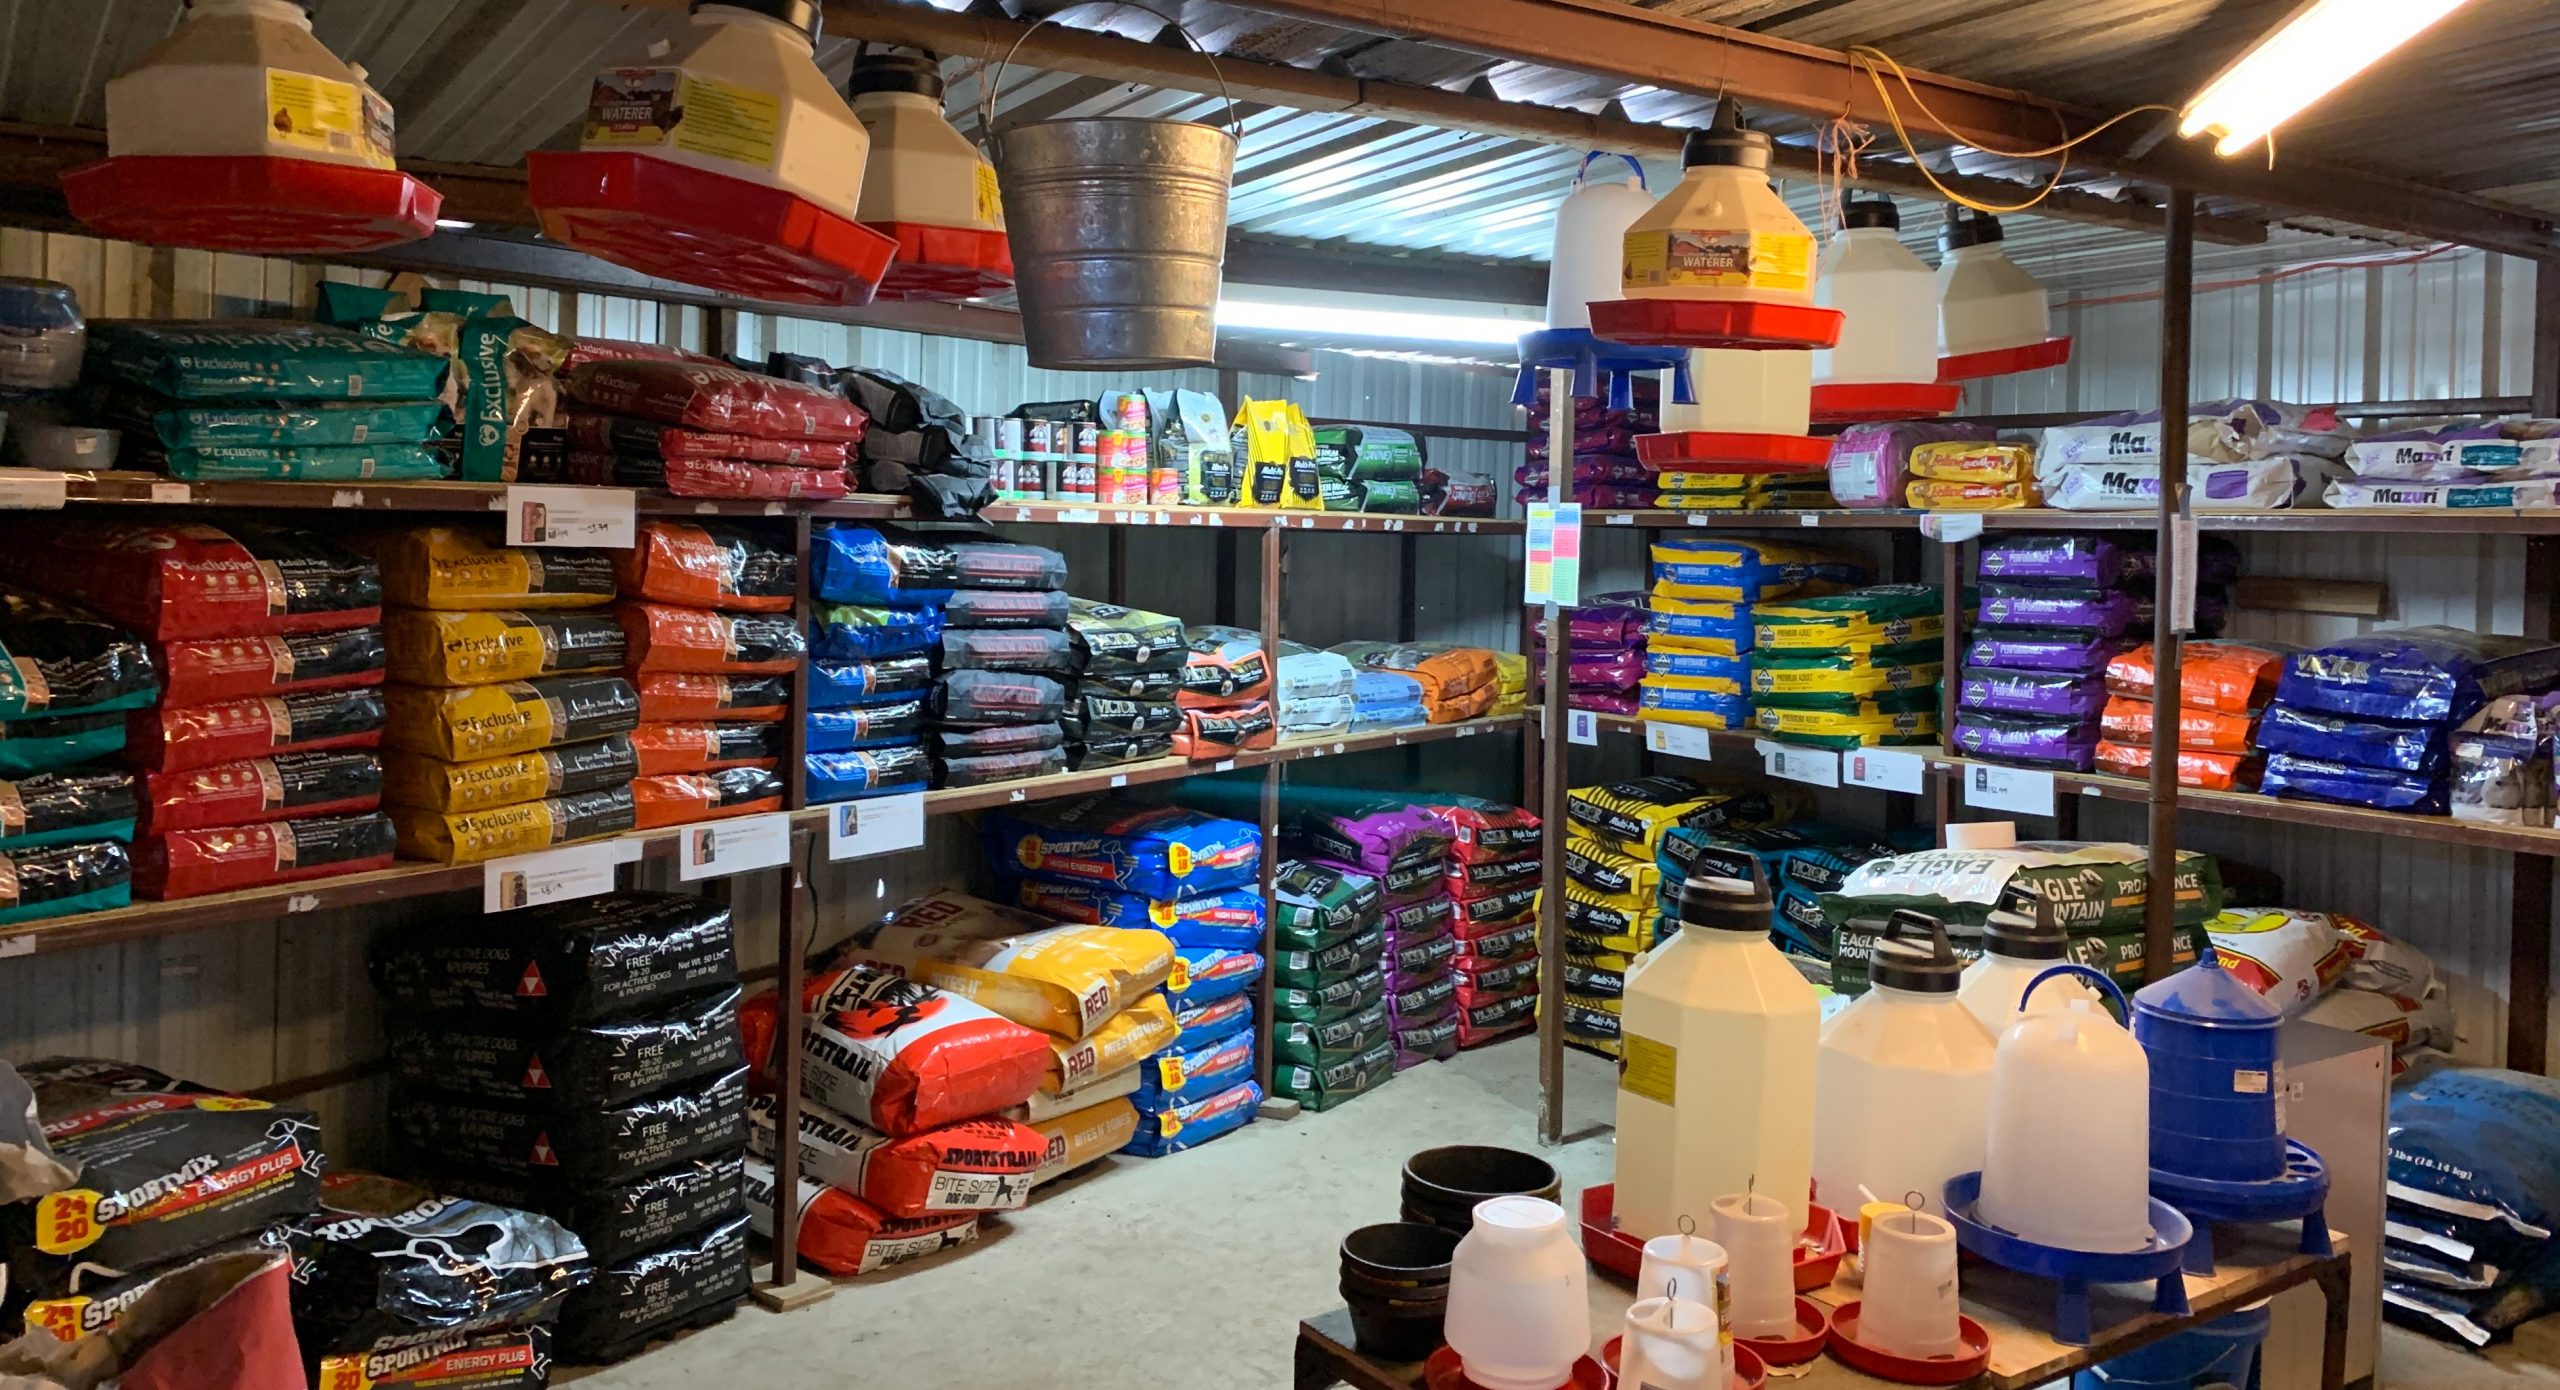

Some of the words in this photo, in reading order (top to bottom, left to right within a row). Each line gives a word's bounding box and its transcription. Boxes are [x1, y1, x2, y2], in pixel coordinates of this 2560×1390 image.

[602, 106, 653, 121] WATERER
[1683, 257, 1734, 268] WATERER
[194, 358, 250, 370] Exclusive
[480, 333, 502, 422] Exclusive
[2373, 487, 2439, 504] Mazuri
[443, 555, 507, 571] Exclusive
[2009, 551, 2050, 563] PERFORMANCE
[464, 635, 525, 652] Exclusive
[2297, 653, 2371, 679] VICTOR
[470, 709, 532, 730] Exclusive
[468, 762, 528, 784] Exclusive
[469, 808, 532, 830] Exclusive
[1609, 816, 1640, 834] Multi-Pro
[1070, 861, 1104, 875] ENERGY
[1791, 859, 1831, 882] VICTOR
[2118, 879, 2141, 895] PRO
[905, 899, 965, 928] RED
[1473, 897, 1504, 915] VICTOR
[1587, 909, 1622, 926] Multi-Pro
[625, 954, 652, 970] FREE
[703, 954, 713, 965] 50
[2120, 944, 2142, 960] PRO
[603, 982, 621, 993] FOR
[622, 976, 650, 990] ACTIVE
[650, 970, 672, 983] DOGS
[626, 982, 657, 997] PUPPIES
[1588, 973, 1622, 988] Multi-Pro
[1085, 986, 1109, 1018] RED
[1584, 1013, 1618, 1030] Multi-Pro
[637, 1043, 665, 1060] FREE
[613, 1071, 631, 1082] FOR
[631, 1065, 661, 1079] ACTIVE
[661, 1058, 684, 1072] DOGS
[1068, 1046, 1095, 1079] RED
[1323, 1062, 1356, 1086] VICTOR
[96, 1099, 166, 1119] PLUS
[642, 1121, 669, 1138] FREE
[718, 1117, 728, 1129] 50
[618, 1150, 637, 1161] FOR
[637, 1143, 666, 1157] ACTIVE
[666, 1135, 689, 1149] DOGS
[1074, 1128, 1097, 1148] BITES
[197, 1170, 258, 1197] ENERGY
[259, 1153, 294, 1176] PLUS
[2396, 1150, 2414, 1163] lbs
[2451, 1165, 2474, 1182] kg)
[934, 1176, 966, 1193] BITE
[968, 1179, 999, 1194] SIZE
[54, 1194, 88, 1220] 24
[644, 1198, 669, 1215] FREE
[945, 1192, 961, 1205] DOG
[961, 1193, 980, 1205] FOOD
[55, 1218, 89, 1244] 20
[620, 1227, 638, 1239] FOR
[638, 1219, 667, 1234] ACTIVE
[667, 1211, 688, 1226] DOGS
[868, 1243, 905, 1257] BITE
[907, 1236, 939, 1254] SIZE
[644, 1277, 671, 1297] FREE
[620, 1308, 638, 1320] FOR
[638, 1299, 667, 1314] ACTIVE
[667, 1291, 690, 1306] DOGS
[42, 1304, 75, 1328] 24
[446, 1352, 496, 1371] ENERGY
[498, 1349, 527, 1364] PLUS
[333, 1370, 361, 1390] 20
